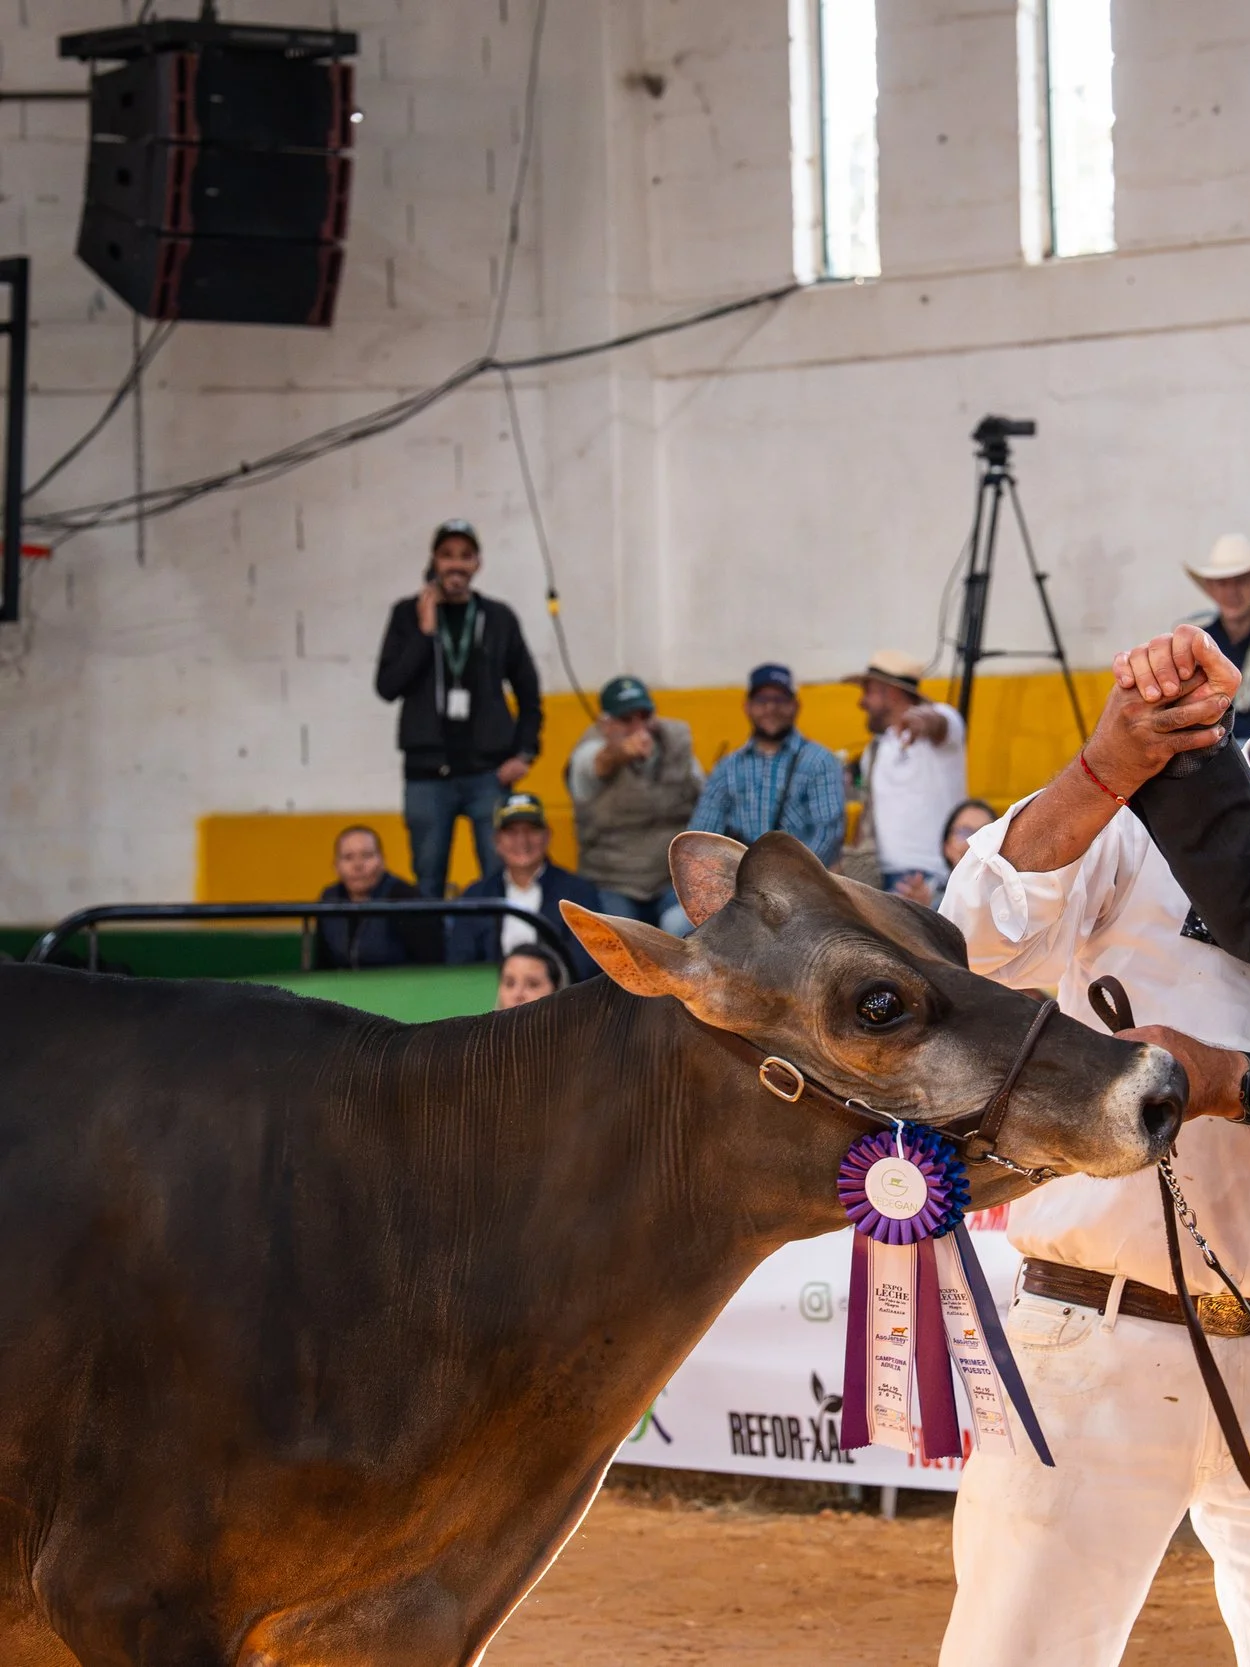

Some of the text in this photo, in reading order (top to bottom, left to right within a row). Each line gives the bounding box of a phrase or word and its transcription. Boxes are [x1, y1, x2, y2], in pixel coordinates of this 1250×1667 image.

[872, 1195, 918, 1212] FEDEGAN
[882, 1283, 903, 1291] EXPO
[875, 1288, 910, 1301] LECHE
[880, 1362, 901, 1371] ADULTA
[959, 1358, 987, 1366] PRIMER
[962, 1367, 991, 1375] PUESTO
[729, 1411, 856, 1464] REFOR-XA
